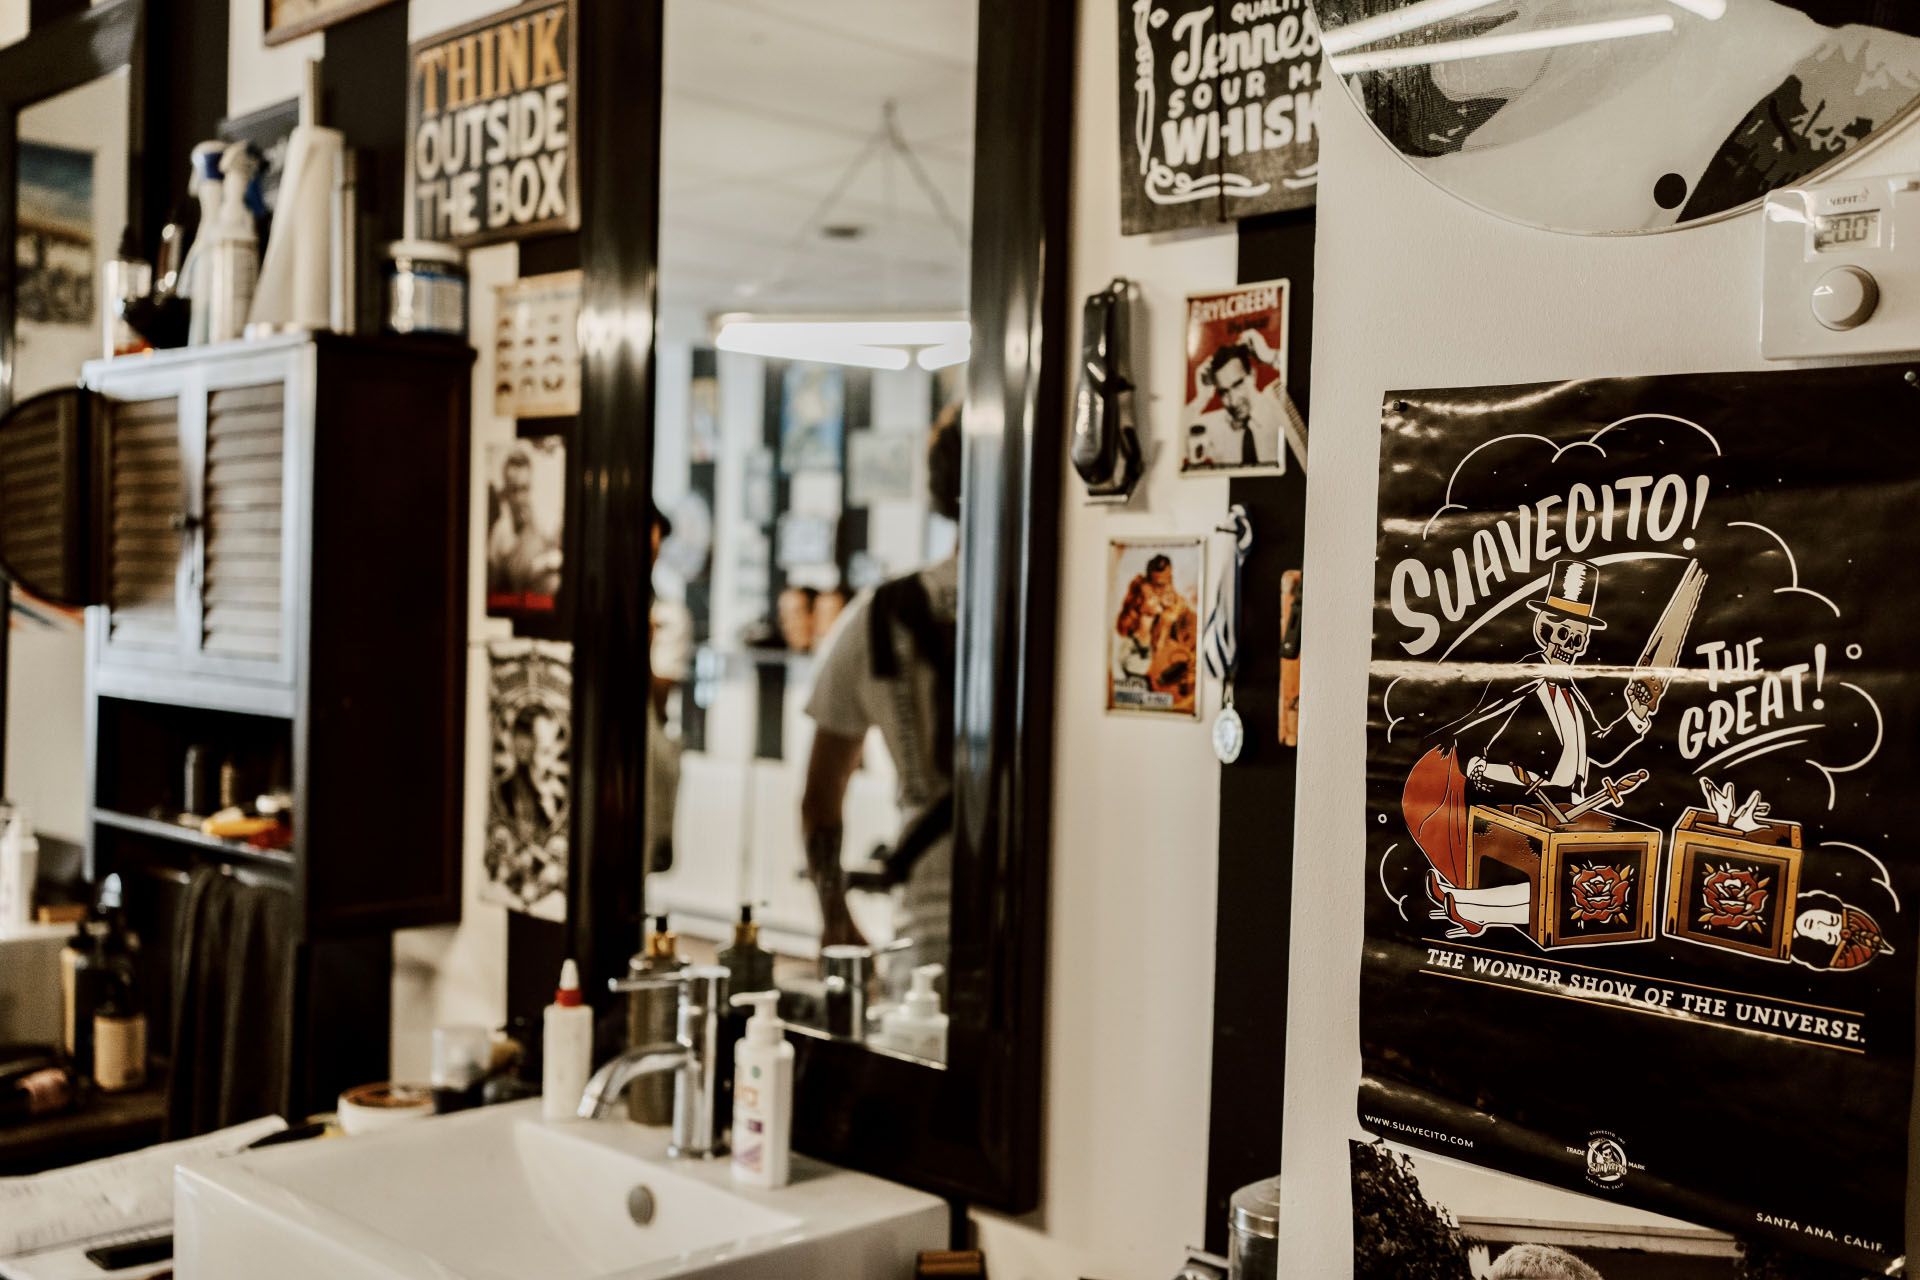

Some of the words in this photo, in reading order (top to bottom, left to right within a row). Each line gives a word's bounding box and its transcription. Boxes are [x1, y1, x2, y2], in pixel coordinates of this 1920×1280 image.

[416, 5, 567, 118] THINK
[1167, 70, 1266, 119] SOUR
[1288, 61, 1321, 90] M
[416, 82, 569, 181] OUTSIDE
[416, 170, 481, 238] THE
[488, 150, 567, 229] BOX
[1389, 473, 1710, 656] SUAVECITO!
[1695, 637, 1764, 691] THE
[1679, 643, 1827, 761] GREAT!
[1427, 948, 1466, 970] THE
[1471, 955, 1562, 987] WONDER
[1569, 974, 1637, 1000] SHOW
[1644, 987, 1674, 1007] OF
[1681, 993, 1727, 1017] THE
[1735, 1002, 1867, 1043] UNIVERSE.
[1364, 1114, 1474, 1148] WWW.SUAVECITO.COM
[1566, 1146, 1585, 1156] TRADE
[1628, 1161, 1646, 1171] MARK
[1756, 1212, 1799, 1231] SANTA
[1844, 1234, 1886, 1253] CALIF.
